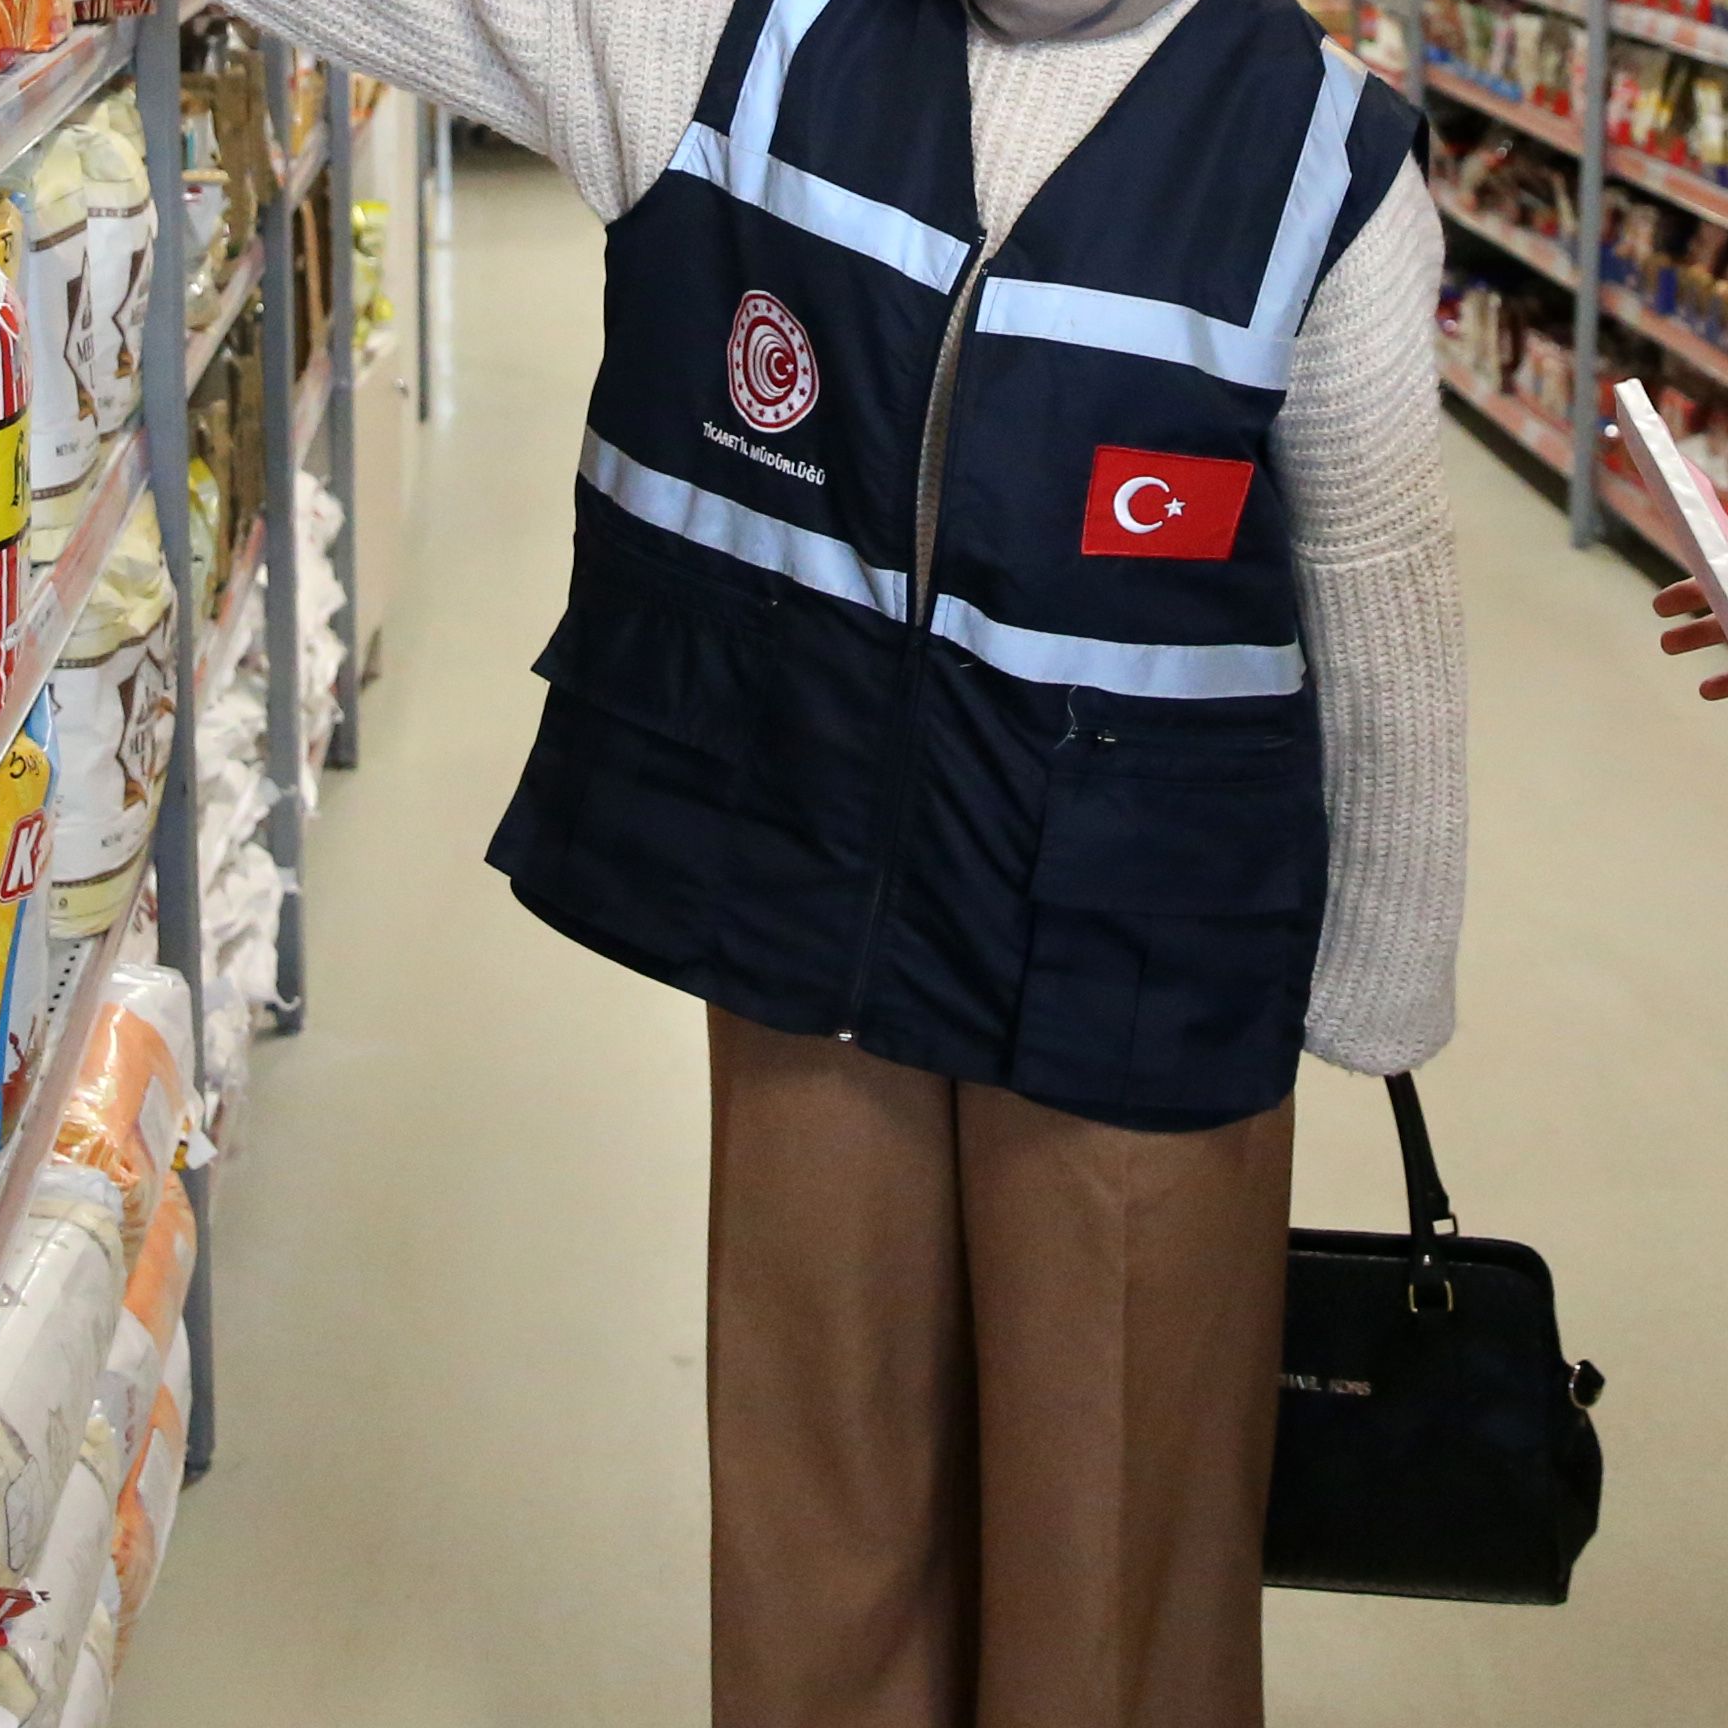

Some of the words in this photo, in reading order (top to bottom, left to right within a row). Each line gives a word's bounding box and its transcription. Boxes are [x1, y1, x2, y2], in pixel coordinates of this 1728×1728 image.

[702, 421, 739, 451] TİCARET
[739, 436, 749, 456] İL
[749, 445, 826, 486] MÜDÜRLÜĞÜ
